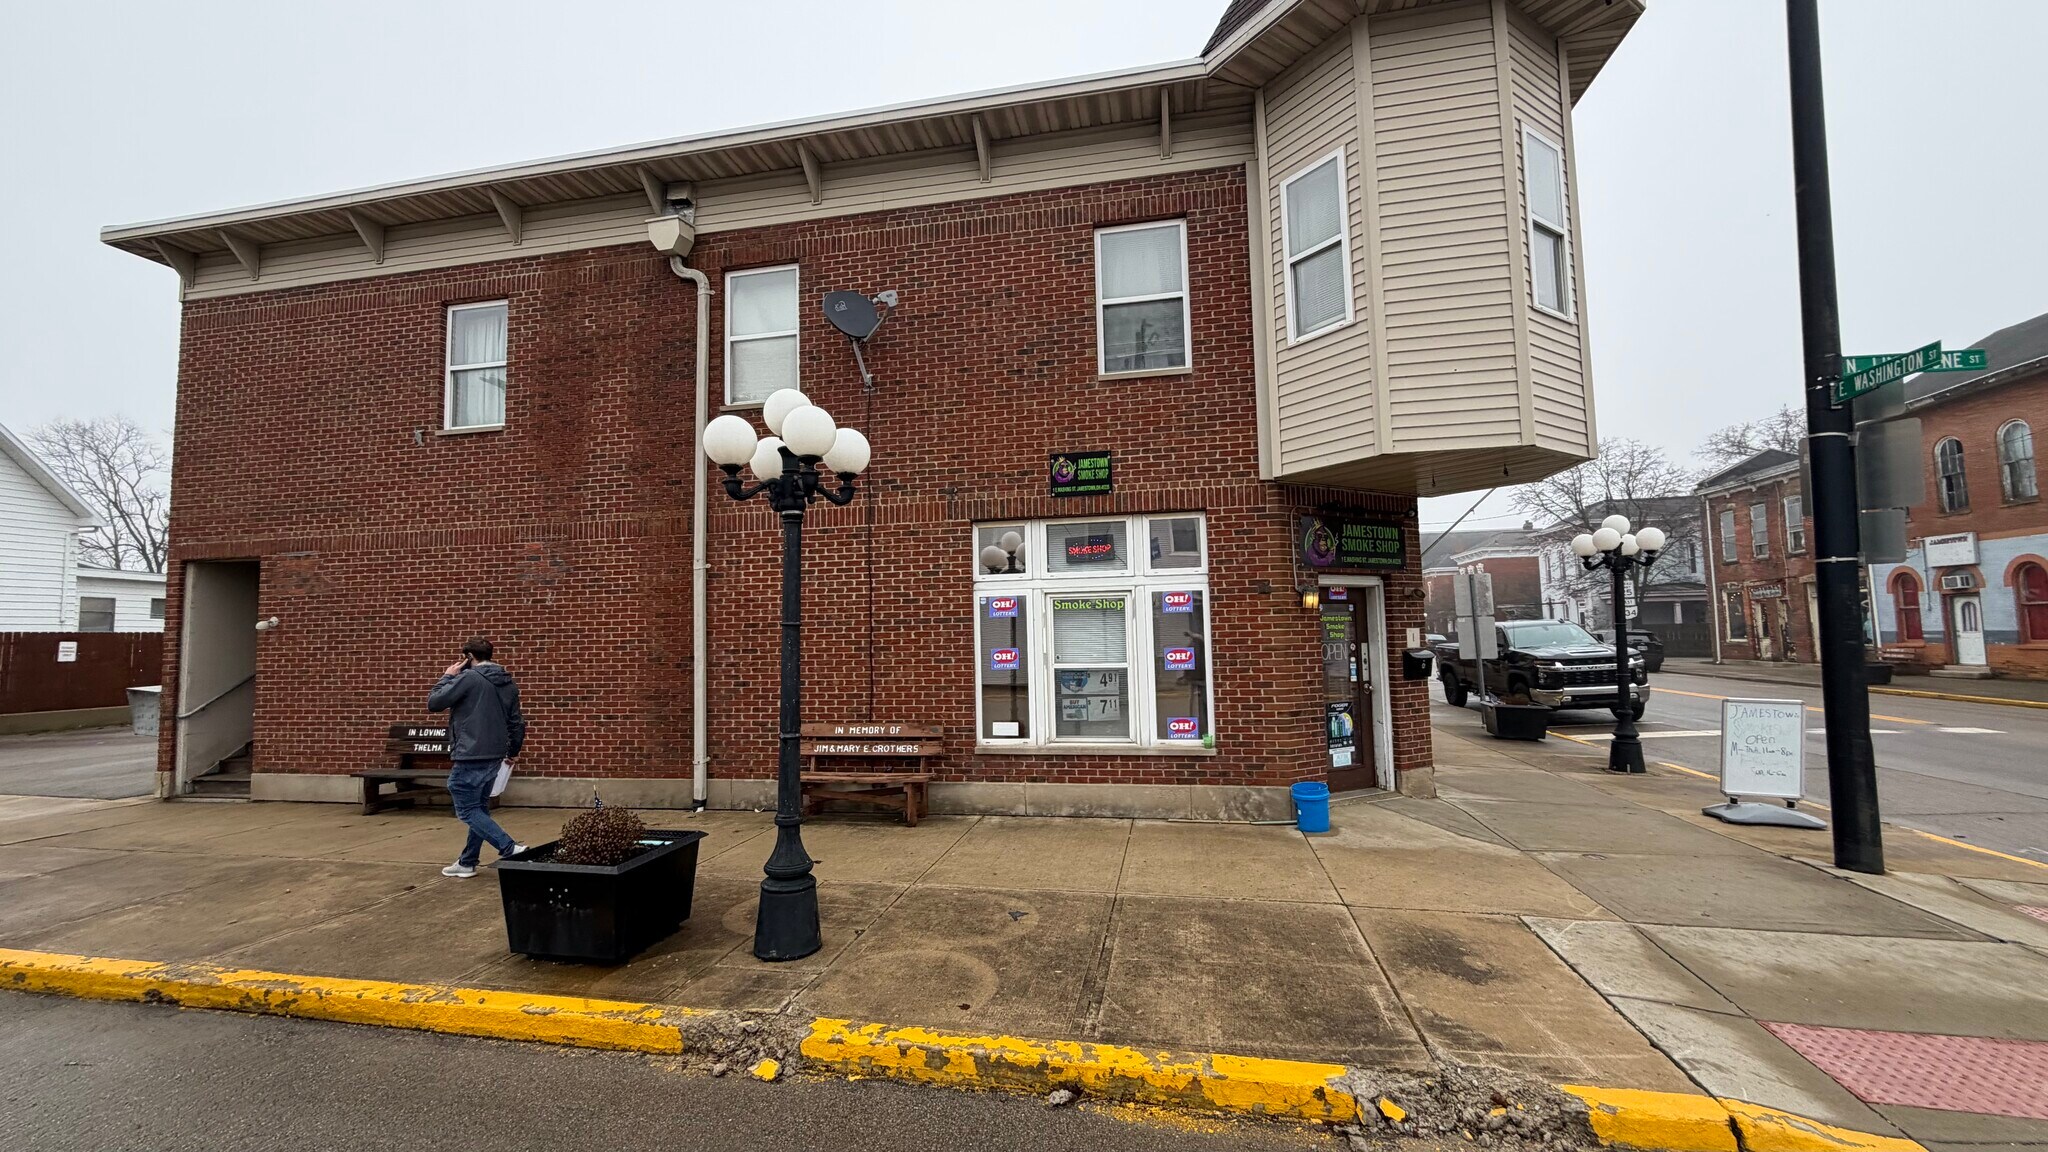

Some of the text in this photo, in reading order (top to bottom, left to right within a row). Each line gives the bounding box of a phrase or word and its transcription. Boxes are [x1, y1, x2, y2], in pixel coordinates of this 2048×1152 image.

[1969, 355, 1980, 363] ST
[1839, 381, 1847, 397] E.
[1854, 350, 1923, 391] WASHINGTON
[1928, 349, 1937, 360] ST
[1078, 457, 1109, 469] JAMESTOWN
[1077, 468, 1109, 480] SMOKE SHOP
[1342, 524, 1398, 540] JAMESTOWN
[1068, 543, 1112, 555] SMOKE SHOP
[1342, 539, 1400, 553] SMOKE SHOP
[1165, 594, 1188, 603] OH!
[992, 599, 1015, 609] OH!
[1054, 599, 1124, 611] Smoke Shop
[1329, 631, 1345, 639] Shop
[993, 651, 1015, 660] OH!
[1166, 652, 1190, 660] OH!
[1321, 643, 1347, 660] OPEN
[835, 726, 902, 734] IN MEMORY OF
[1170, 721, 1194, 730] OH!
[413, 743, 442, 751] THELMA
[872, 744, 919, 753] CROTHERS
